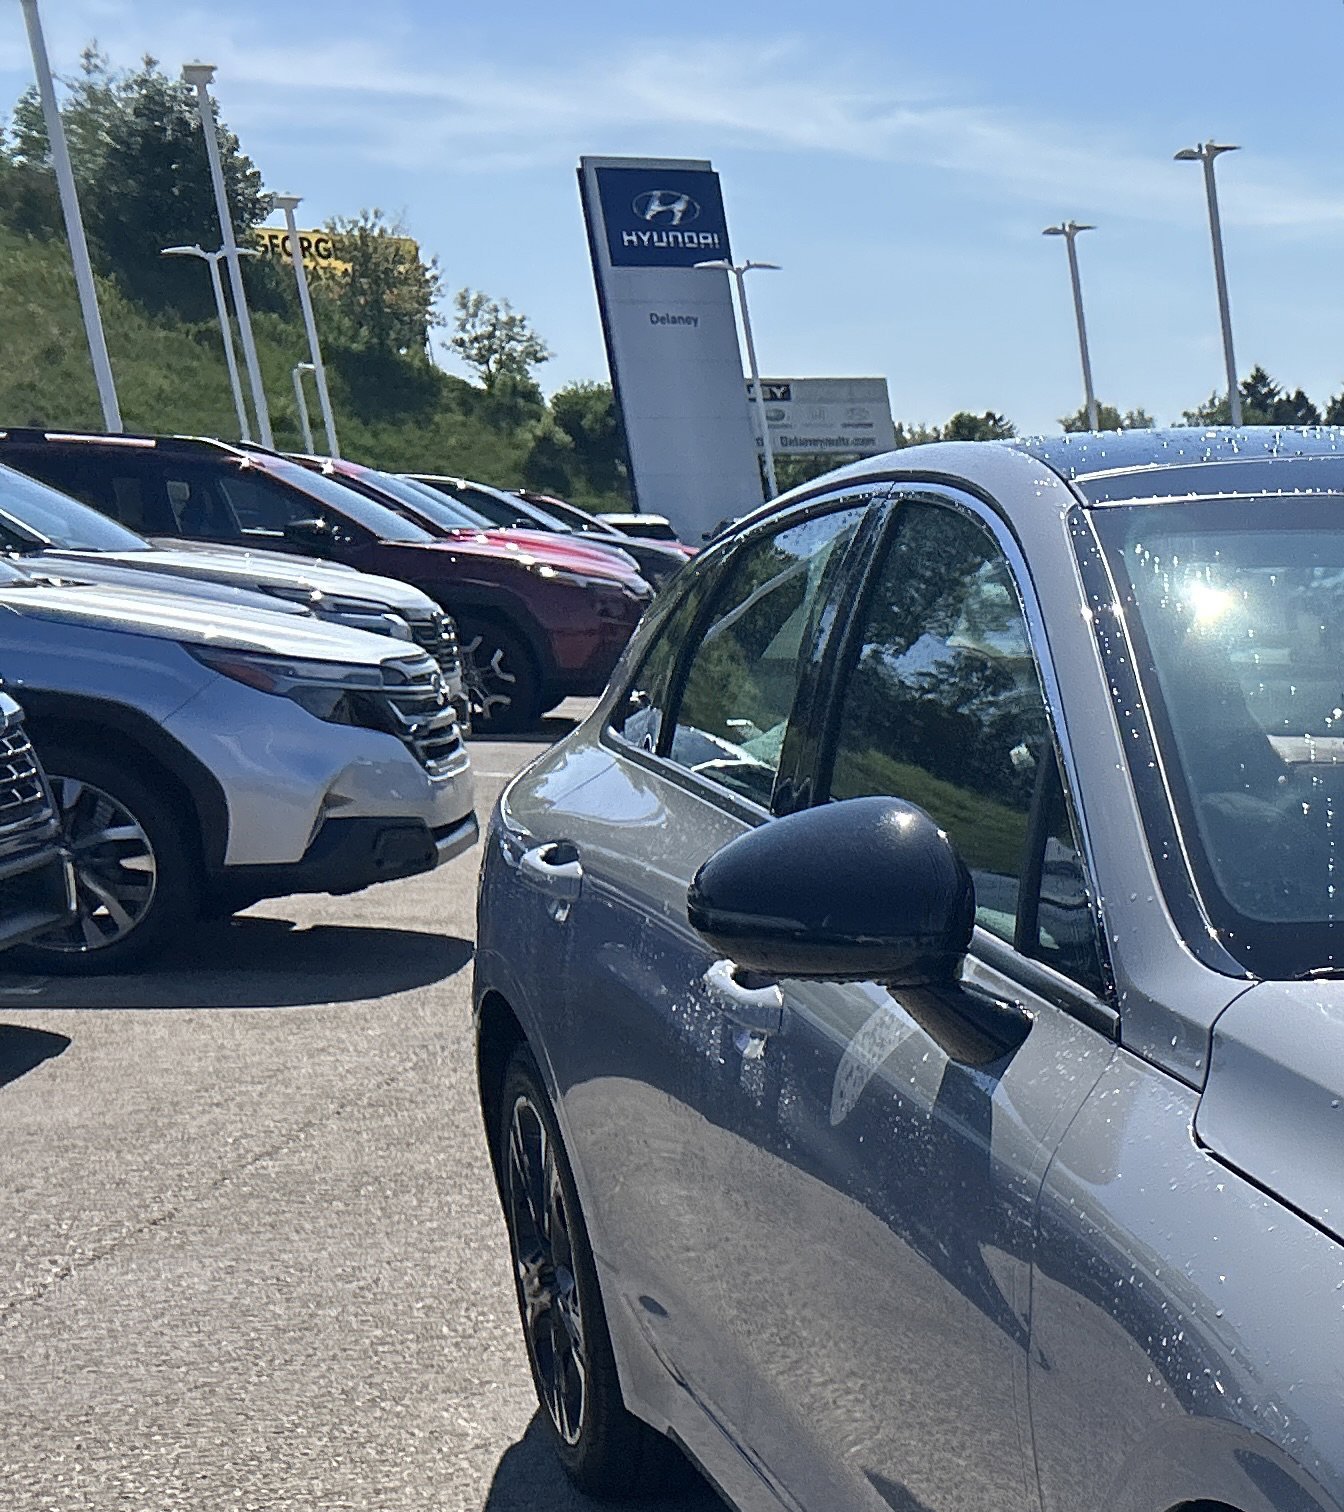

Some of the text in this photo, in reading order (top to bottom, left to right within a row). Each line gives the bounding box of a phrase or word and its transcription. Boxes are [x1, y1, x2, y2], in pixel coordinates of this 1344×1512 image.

[255, 233, 335, 260] GEORG
[622, 230, 720, 248] HYUNDAI
[650, 312, 699, 327] Delaney
